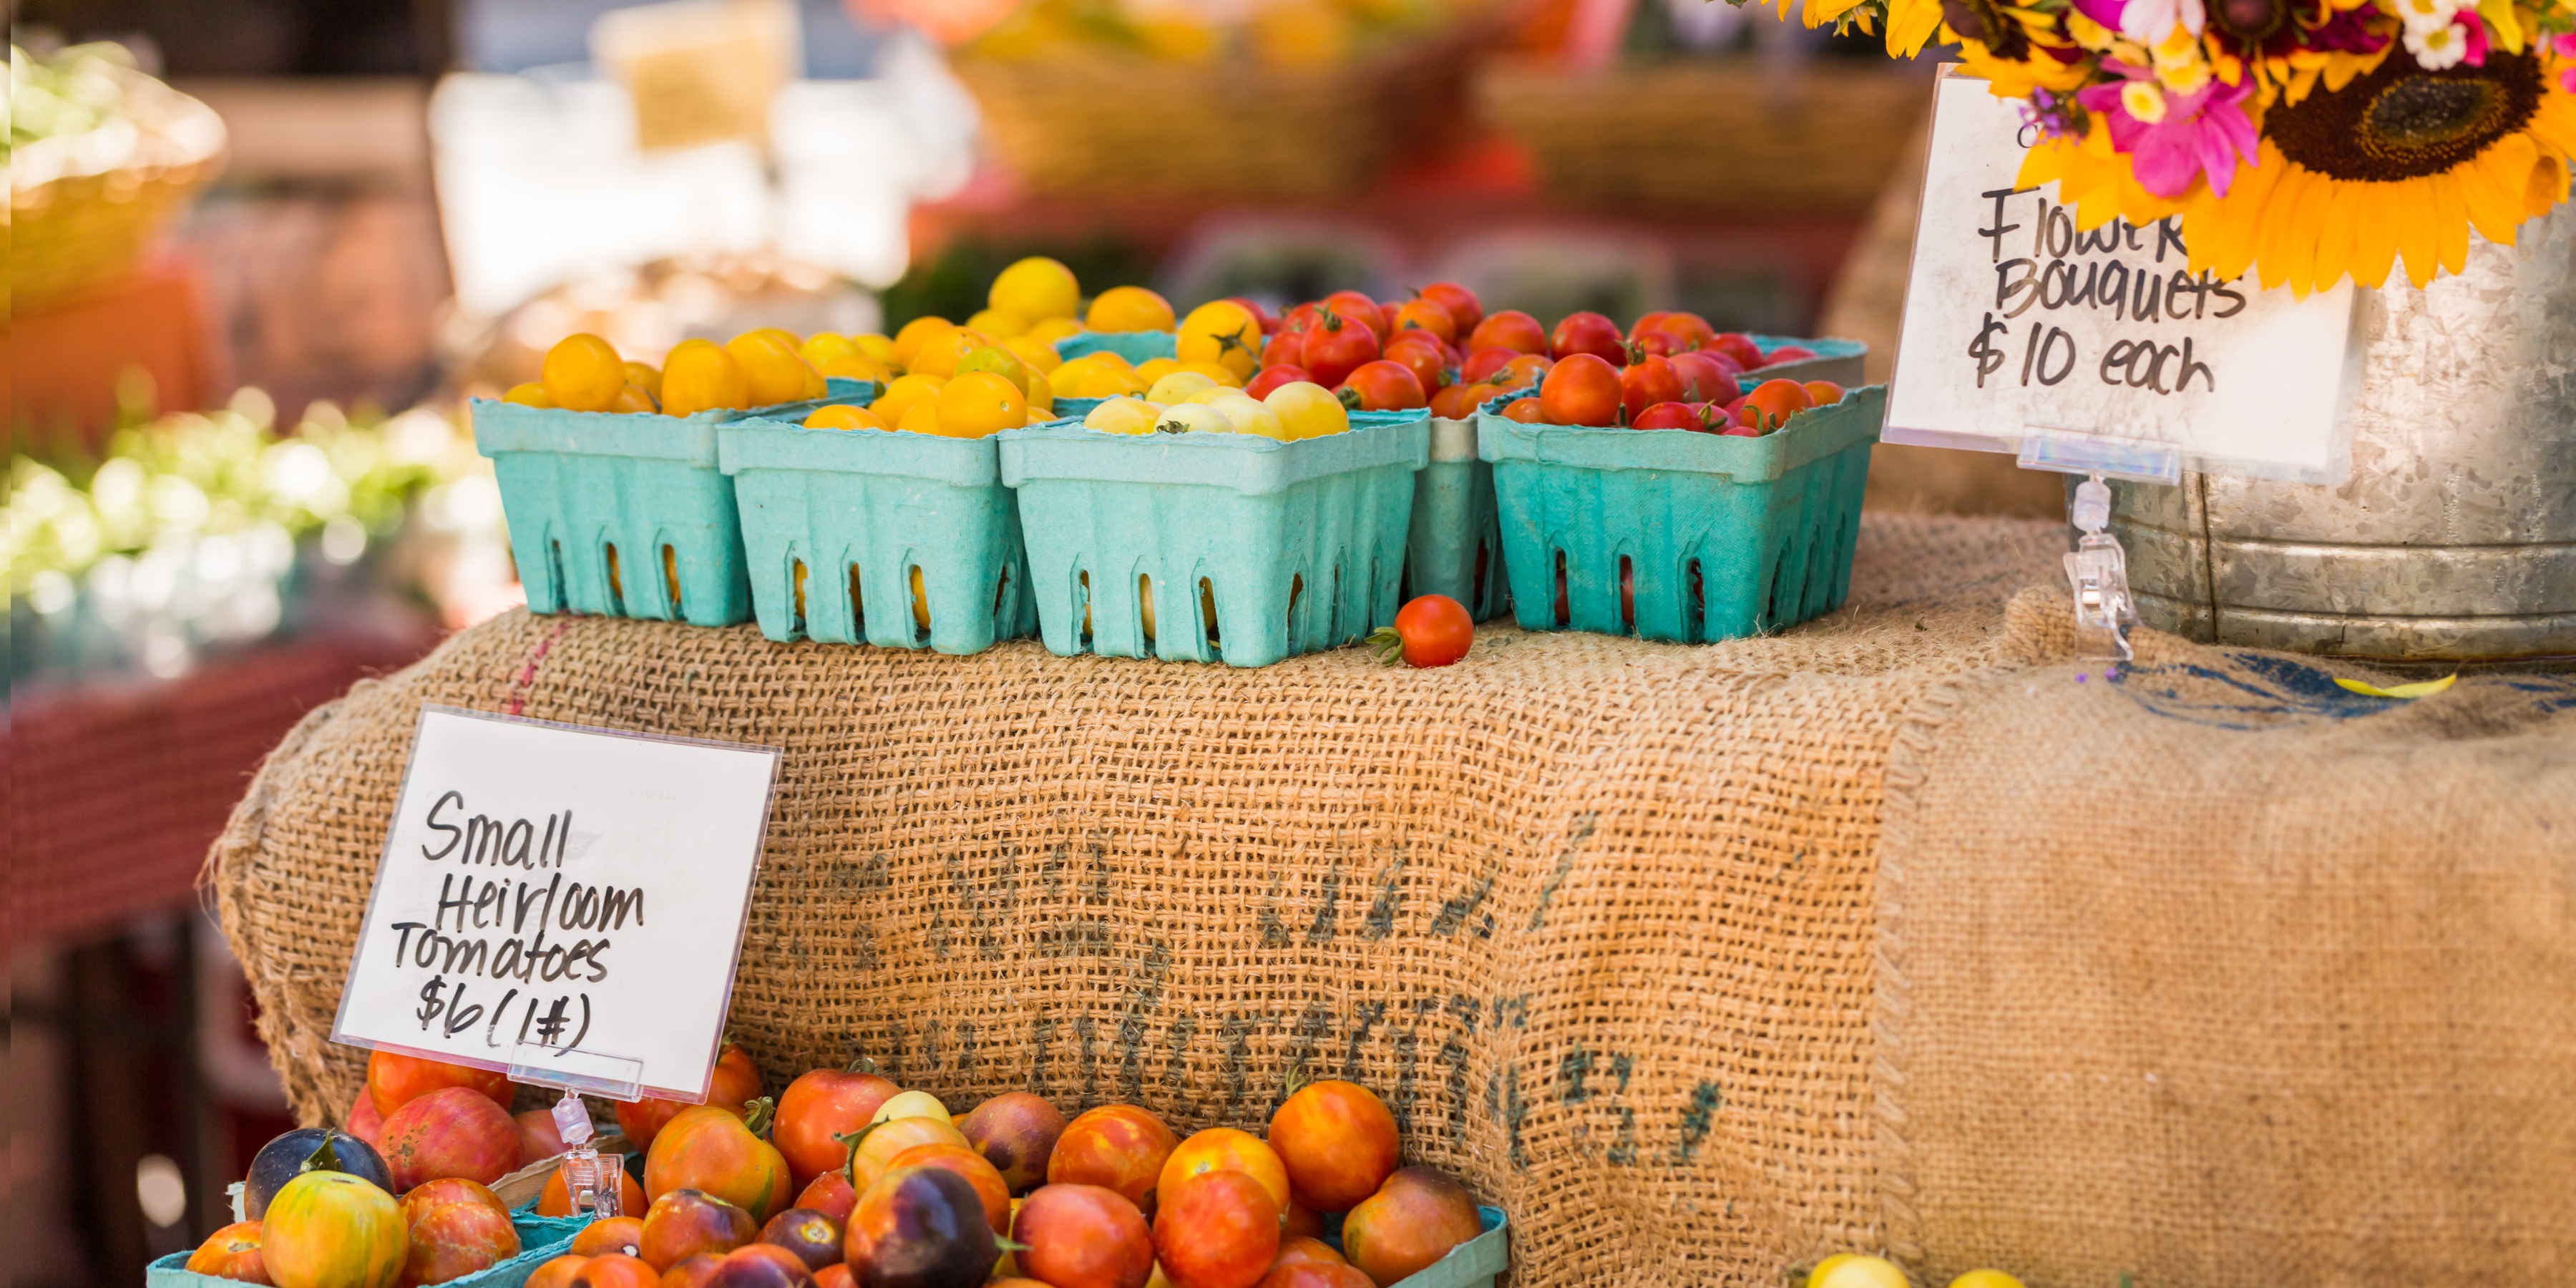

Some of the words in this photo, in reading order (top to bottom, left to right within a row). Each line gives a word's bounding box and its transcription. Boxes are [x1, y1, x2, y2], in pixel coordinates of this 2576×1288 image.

[1995, 258, 2246, 323] Bouquets
[2100, 336, 2215, 395] each
[421, 791, 572, 870] Small
[434, 872, 643, 935] Heirloom
[391, 921, 611, 985] Tomatoes
